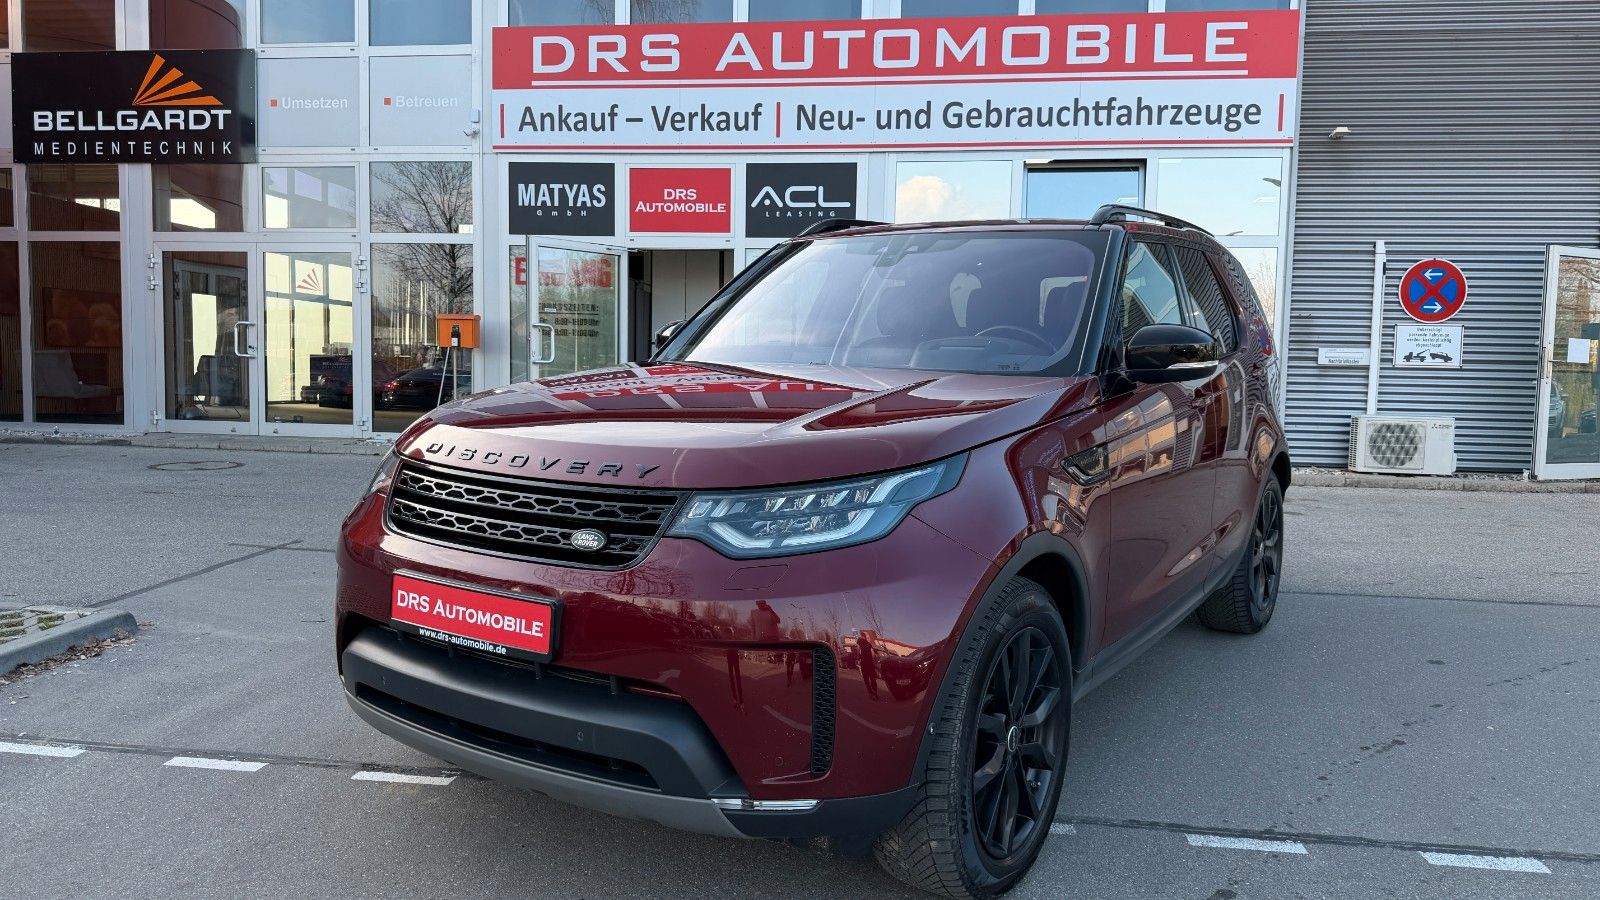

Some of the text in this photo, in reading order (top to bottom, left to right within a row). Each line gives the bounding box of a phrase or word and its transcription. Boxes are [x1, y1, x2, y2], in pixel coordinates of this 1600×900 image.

[532, 21, 1249, 74] DRS AUTOMOBILE
[282, 96, 348, 109] Umsetzen
[396, 95, 458, 108] Betreuen
[33, 109, 232, 131] BELLGARDT
[518, 103, 619, 133] Ankauf
[651, 102, 763, 132] Verkauf
[796, 103, 865, 132] Neu-
[875, 100, 932, 130] und
[942, 96, 1262, 133] Gebrauchtfahrzeuge
[34, 141, 232, 155] MEDIENTECHNIK
[517, 183, 607, 208] MATYAS
[663, 188, 697, 200] DRS
[750, 185, 851, 208] ACL
[635, 200, 726, 213] AUTOMOBILE
[765, 210, 836, 218] LEASING
[425, 442, 660, 478] DISCOVERY
[576, 539, 599, 547] ROVER
[577, 533, 595, 541] LAND
[397, 590, 544, 638] DRS AUTOMOBILE
[419, 628, 507, 655] www.drs-automobile.de
